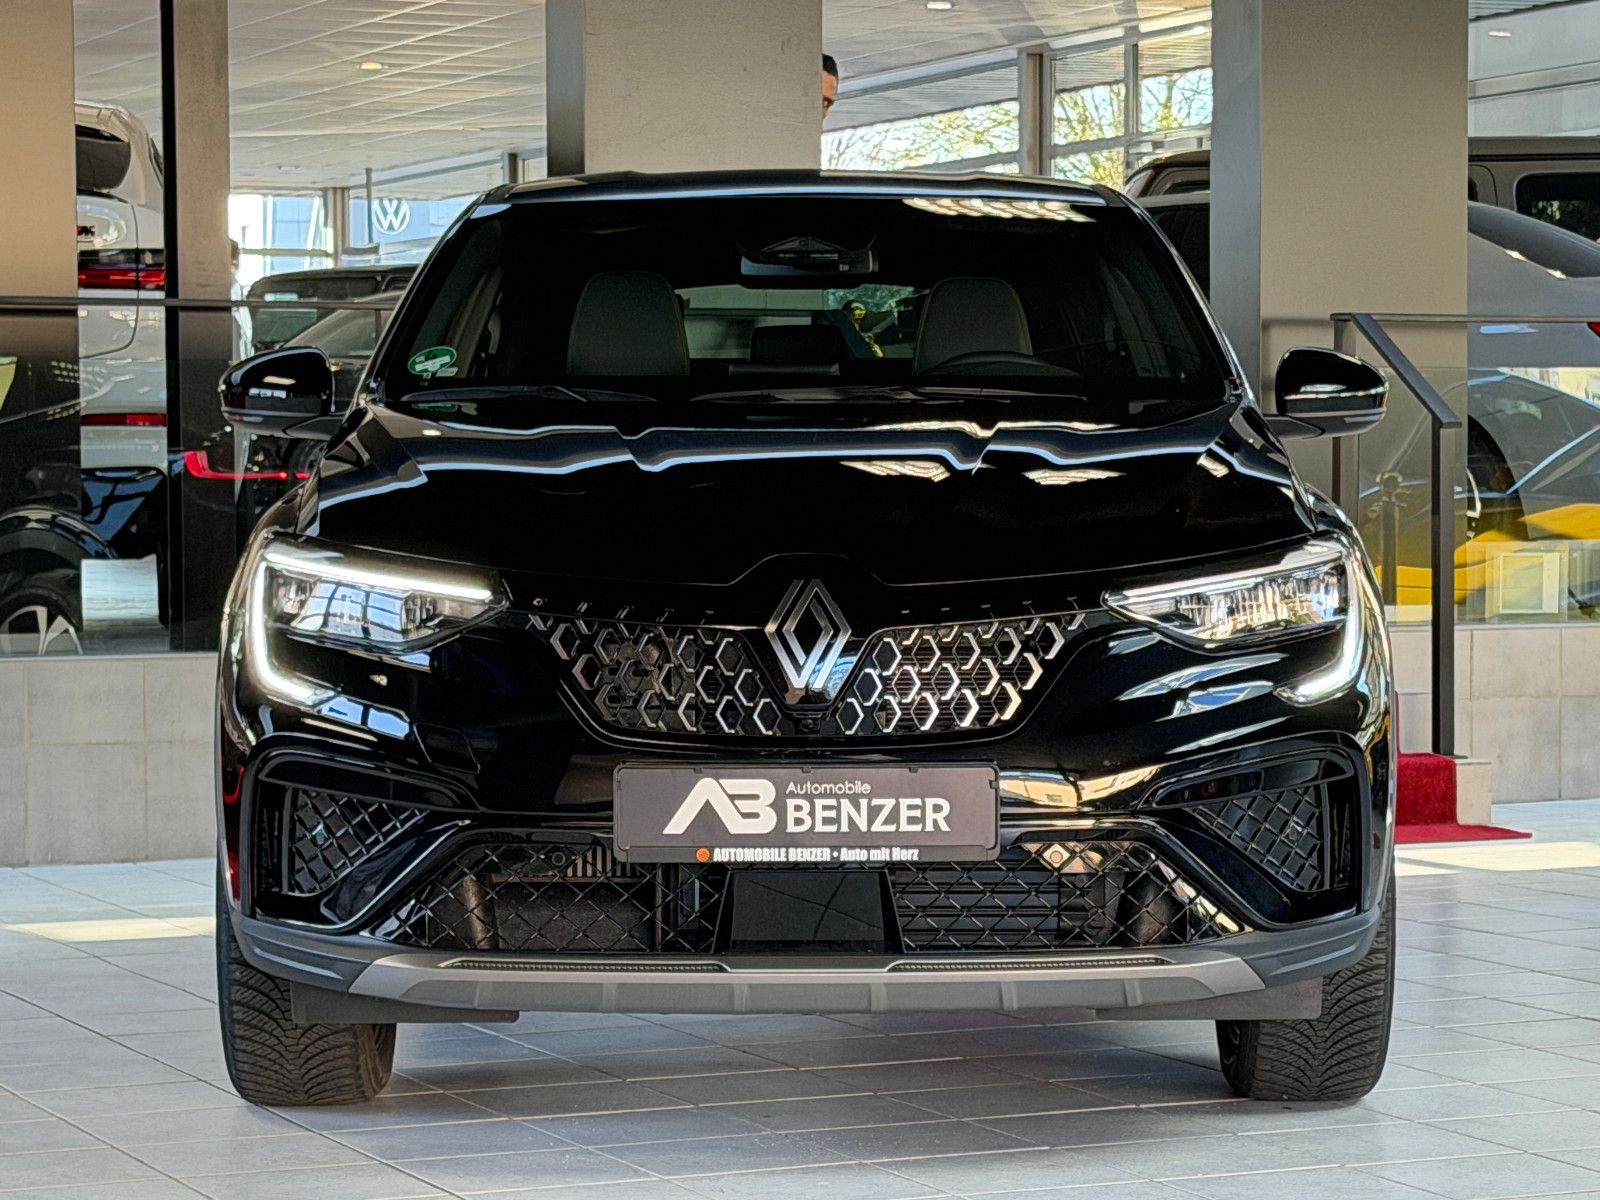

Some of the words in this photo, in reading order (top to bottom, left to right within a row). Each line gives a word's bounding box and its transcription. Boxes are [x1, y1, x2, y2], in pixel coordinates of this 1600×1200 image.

[372, 198, 410, 235] VW
[786, 780, 872, 795] Automobile
[662, 777, 777, 835] AB
[785, 797, 952, 833] BENZER
[713, 848, 786, 862] AUTOMOBILE
[788, 847, 831, 862] BENZER
[839, 847, 868, 861] Auto
[869, 847, 891, 861] mit
[891, 846, 920, 861] Herz
